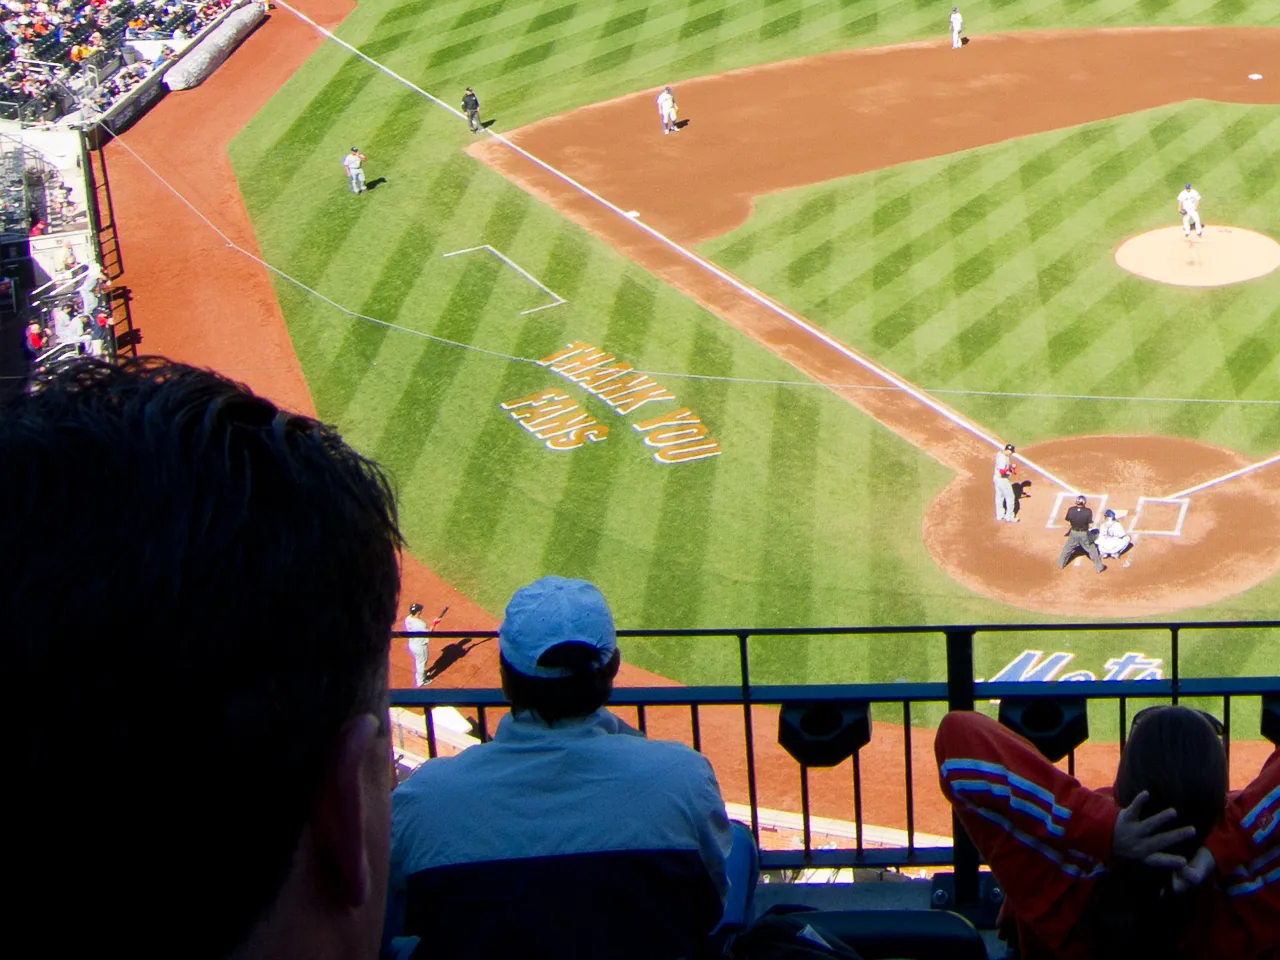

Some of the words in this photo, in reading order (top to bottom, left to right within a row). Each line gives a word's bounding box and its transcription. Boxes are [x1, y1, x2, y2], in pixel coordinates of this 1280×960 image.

[500, 388, 610, 451] FANS
[536, 341, 676, 416] THANK
[632, 407, 722, 465] YOU
